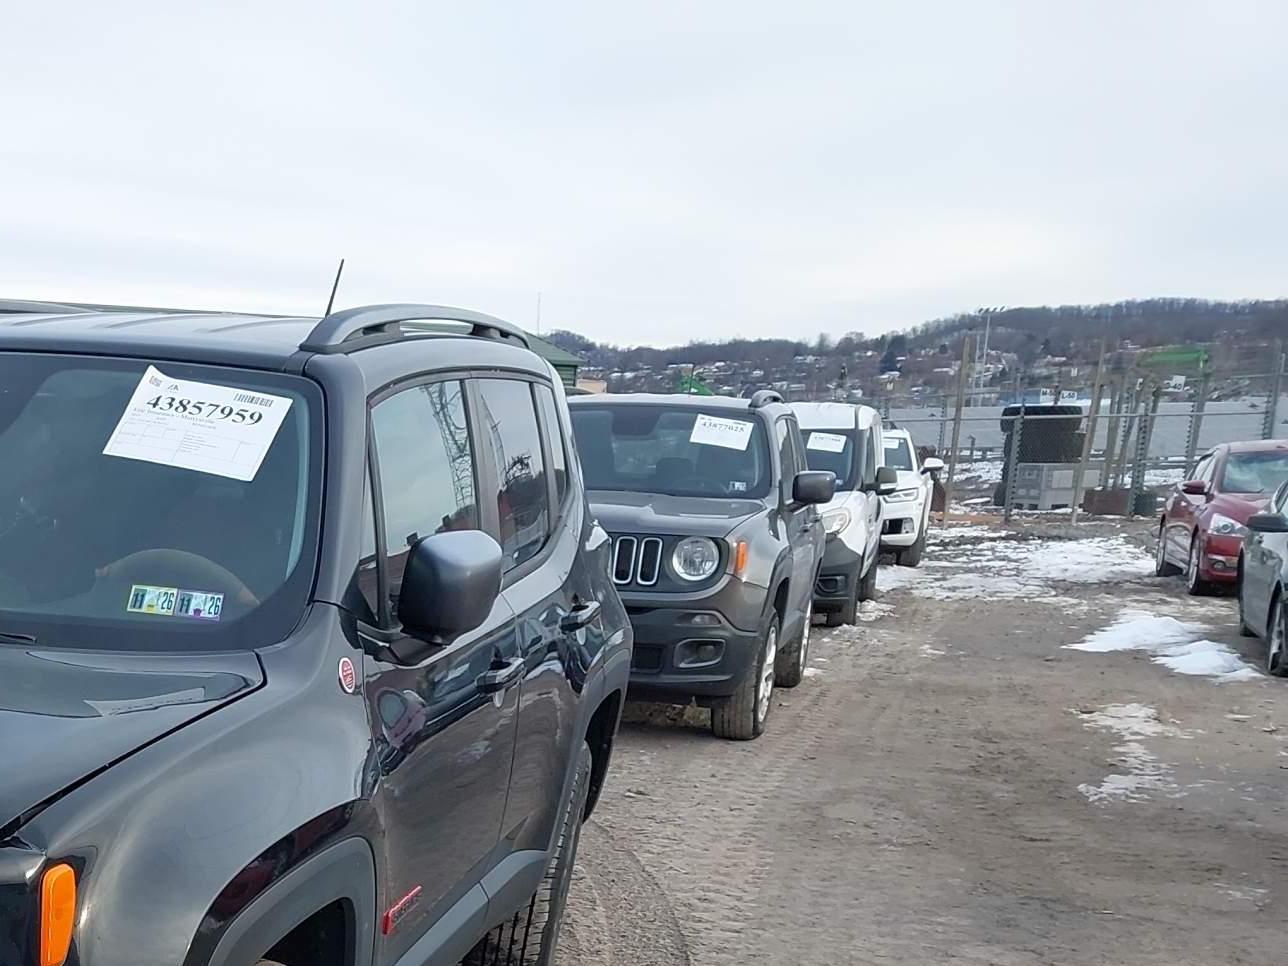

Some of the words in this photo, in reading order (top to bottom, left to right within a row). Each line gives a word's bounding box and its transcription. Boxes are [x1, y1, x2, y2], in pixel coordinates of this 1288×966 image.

[147, 394, 264, 426] 43857959
[132, 592, 146, 609] 11
[161, 592, 175, 610] 26
[179, 597, 191, 614] 11
[208, 596, 221, 615] 26
